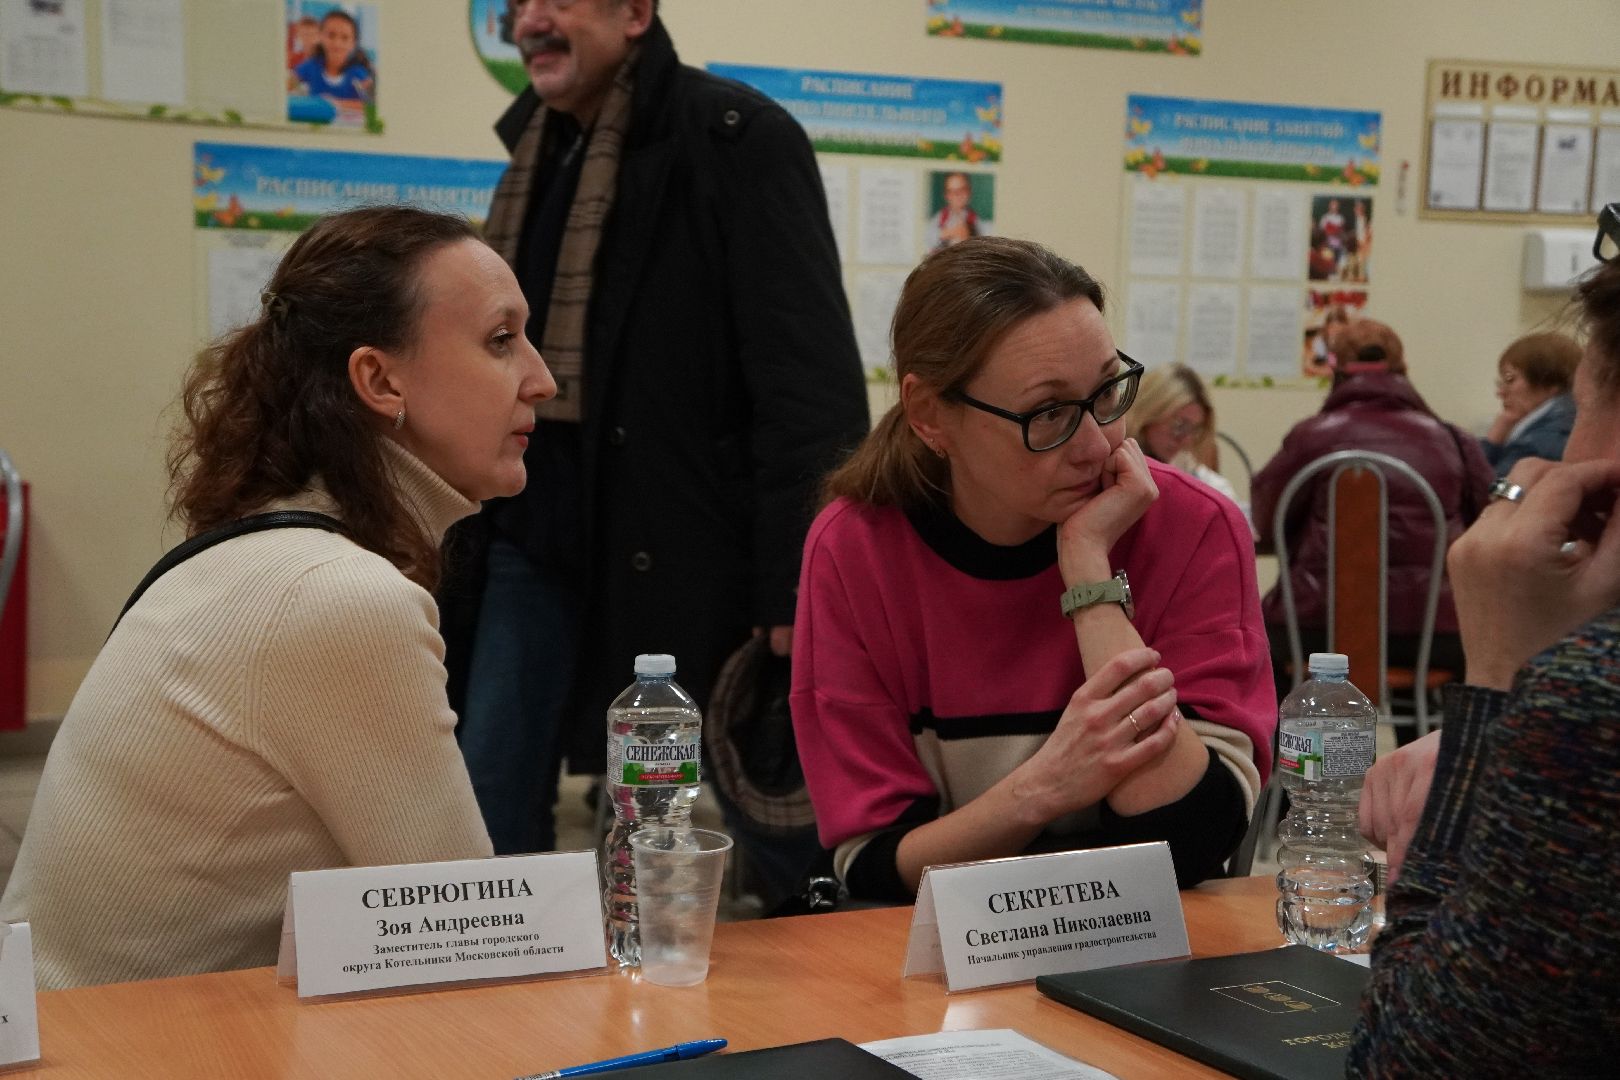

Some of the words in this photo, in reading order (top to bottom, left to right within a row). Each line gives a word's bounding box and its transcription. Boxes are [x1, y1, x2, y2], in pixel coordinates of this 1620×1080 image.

[1441, 70, 1620, 106] ИНФОРМА
[256, 175, 397, 200] РАСПИСАНИЕ
[626, 743, 696, 761] СЕНЕЖСКАЯ
[362, 878, 534, 909] СЕВРЮГИНА
[988, 879, 1121, 914] СЕКРЕТЕВА
[376, 919, 412, 937] Зоя
[419, 911, 525, 935] Андреевна
[966, 924, 1049, 947] Светлана
[1052, 910, 1152, 935] Николаевна
[373, 940, 443, 955] Заместитель
[446, 938, 479, 949] главы
[482, 932, 540, 947] городского
[967, 951, 1020, 965] Начальник
[1021, 943, 1072, 959] управления
[1075, 930, 1157, 950] градостроительства
[342, 961, 382, 974] округа
[384, 955, 452, 969] Котельники
[455, 946, 521, 963] Московской
[523, 944, 564, 957] области
